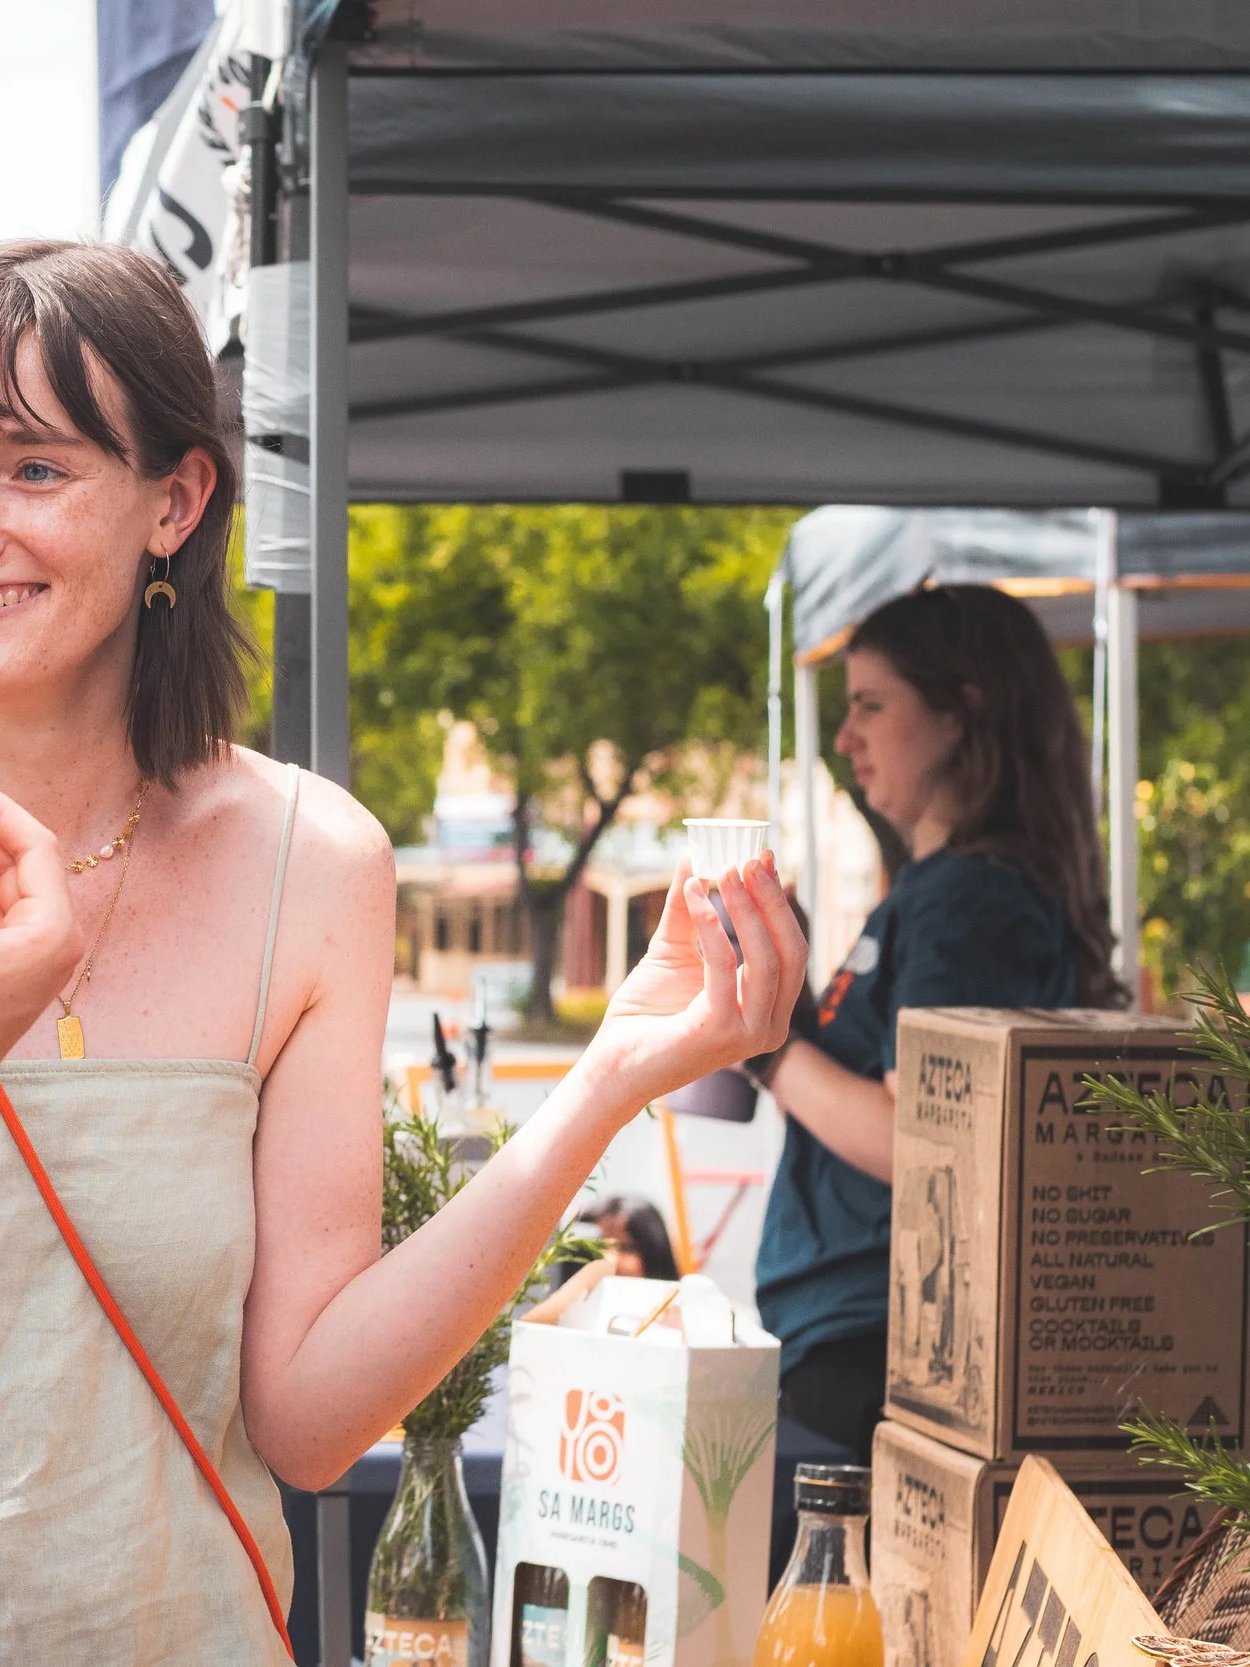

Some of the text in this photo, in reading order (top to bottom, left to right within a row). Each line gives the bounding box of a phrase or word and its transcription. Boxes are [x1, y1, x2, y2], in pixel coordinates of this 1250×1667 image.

[918, 1052, 972, 1104] AZTECA
[1031, 1186, 1112, 1201] NO SHIT
[1031, 1208, 1131, 1223] NO SUGAR
[1030, 1230, 1060, 1246] NO
[1031, 1253, 1154, 1268] ALL NATURAL
[1030, 1275, 1096, 1290] VEGAN
[1029, 1297, 1155, 1312] GLUTEN FREE
[1029, 1319, 1141, 1334] COCKTAILS
[1028, 1335, 1174, 1351] OR MOCKTAILS
[538, 1490, 636, 1534] SA MARGS
